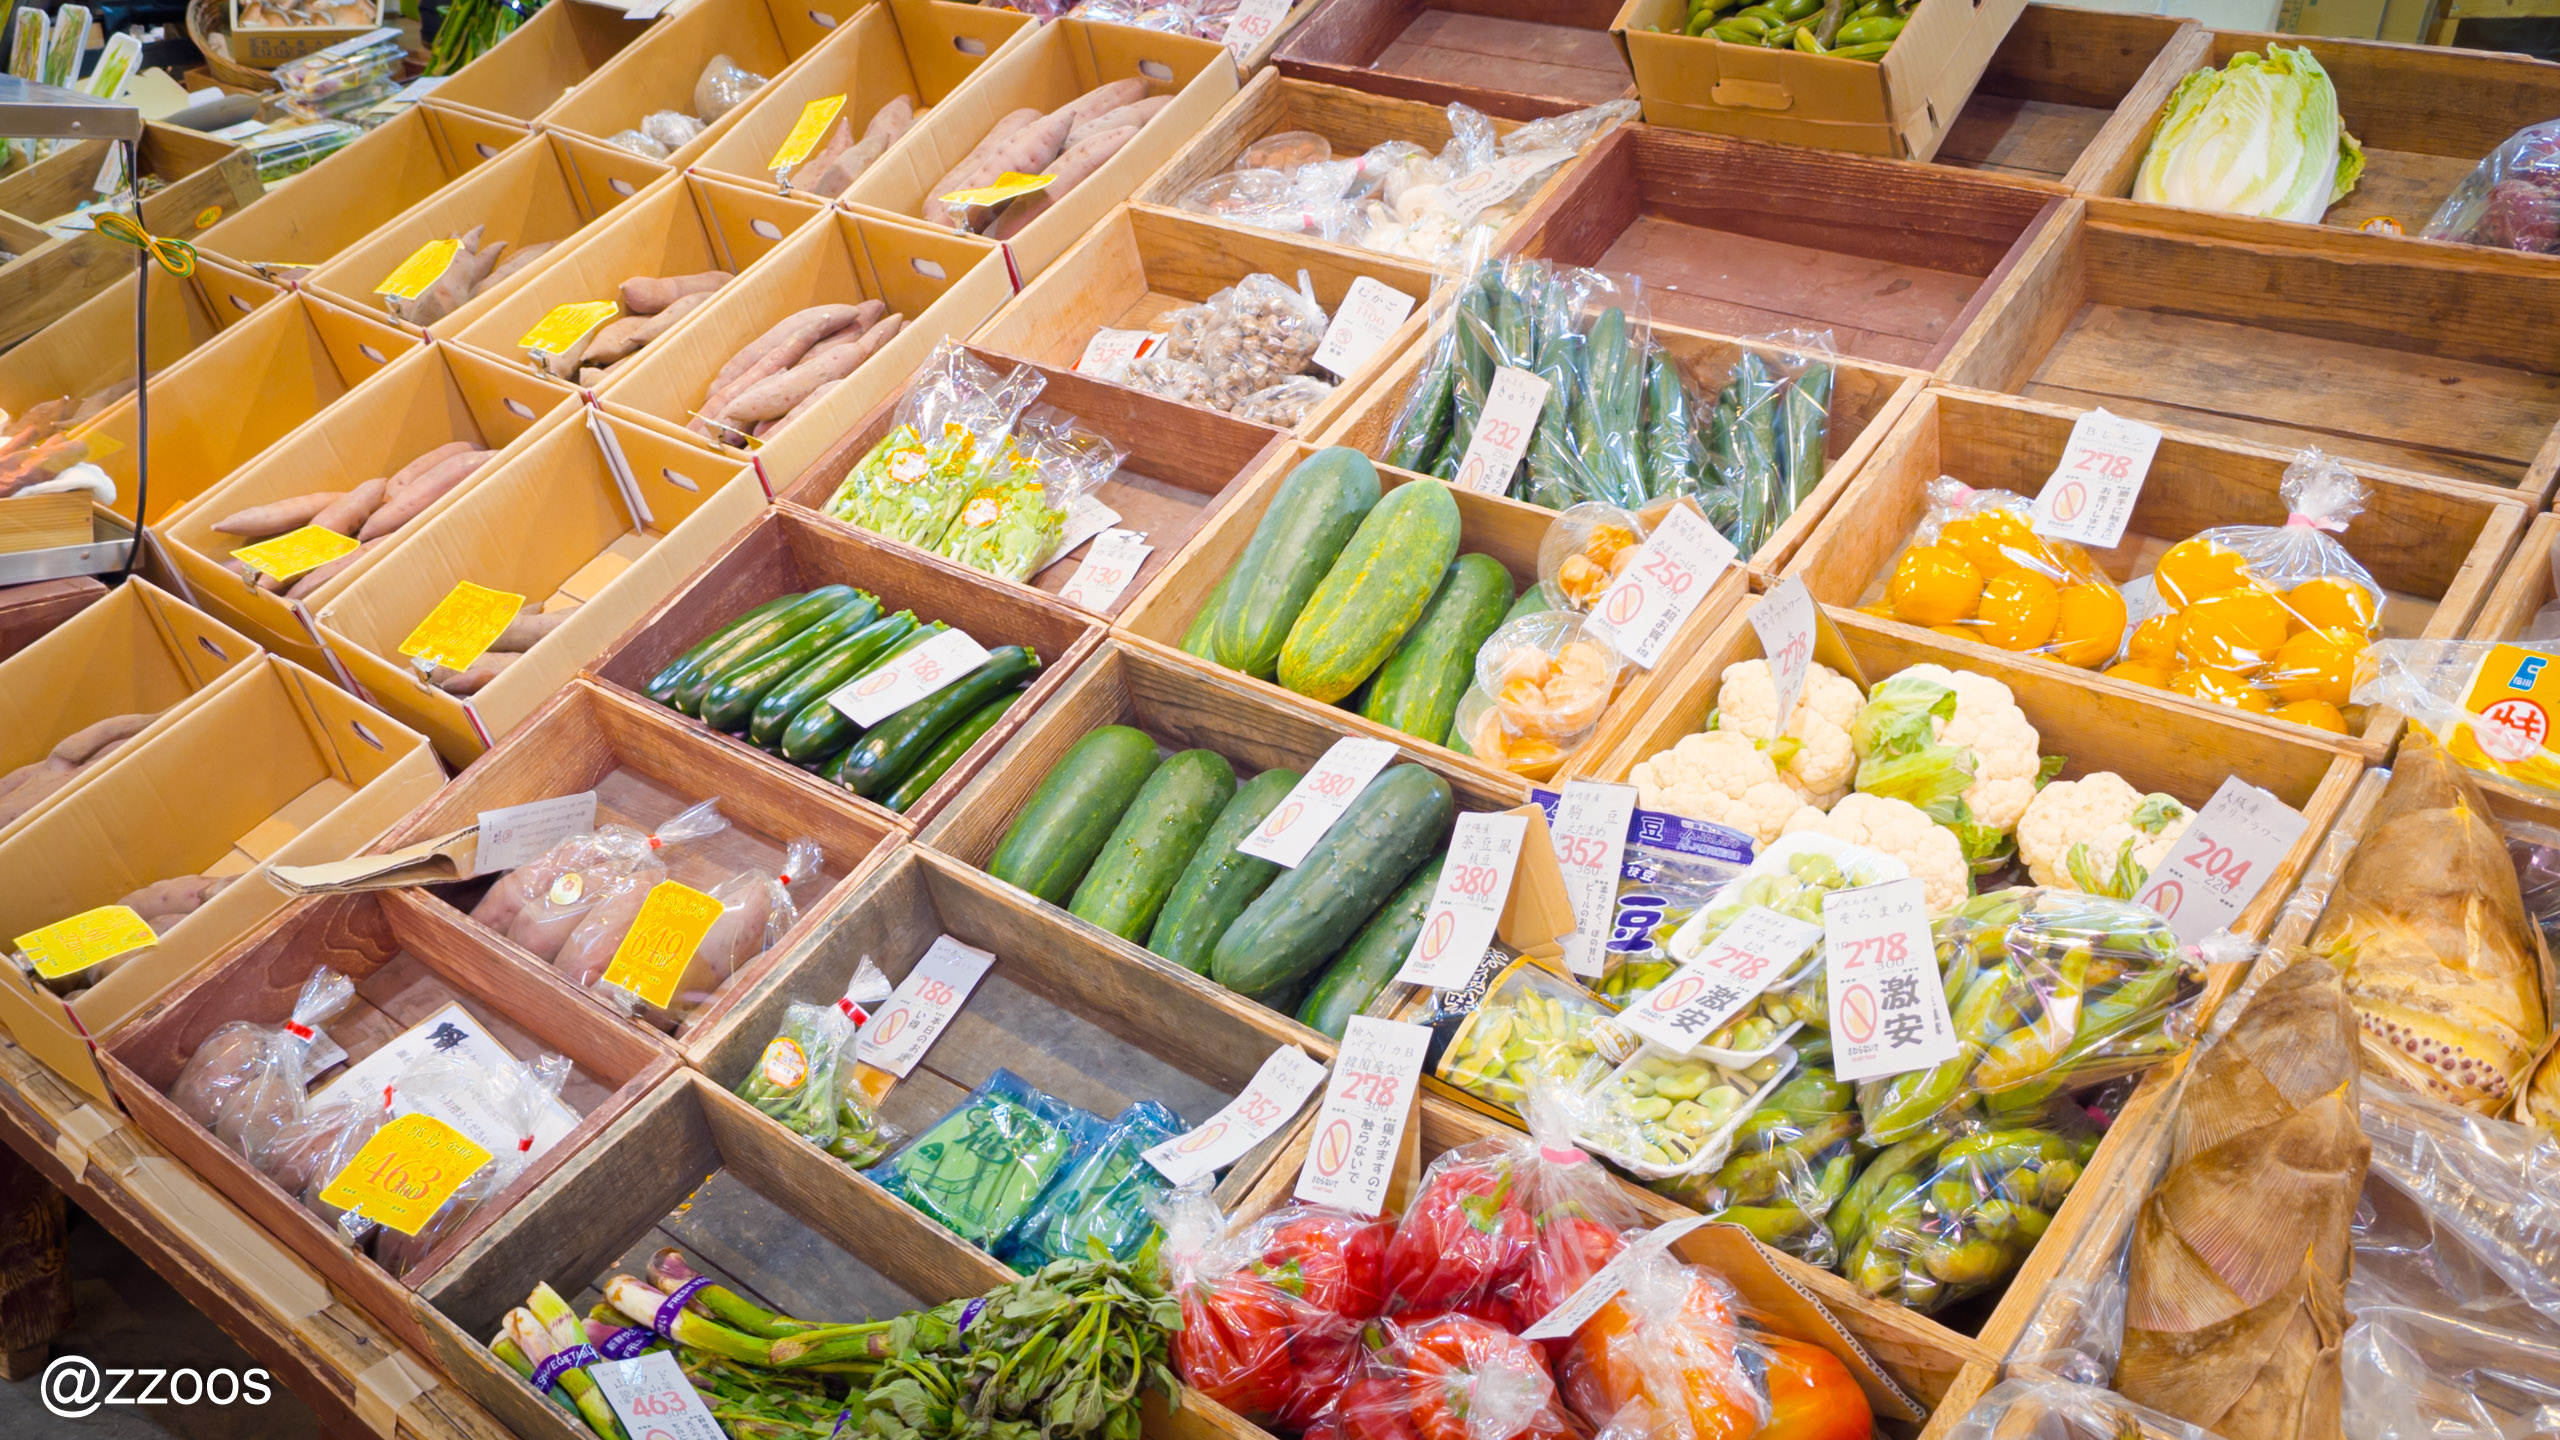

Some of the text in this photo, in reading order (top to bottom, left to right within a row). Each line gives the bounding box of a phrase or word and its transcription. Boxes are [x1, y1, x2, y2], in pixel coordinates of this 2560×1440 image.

[1238, 14, 1271, 37] 453
[1498, 385, 1536, 408] きゅうり
[1482, 418, 1521, 451] 232
[2074, 449, 2133, 479] 278
[2083, 487, 2111, 537] お売りしません
[1086, 564, 1123, 586] 130
[1642, 551, 1693, 595] 250
[908, 652, 945, 683] 186
[1780, 631, 1807, 678] 278
[1308, 771, 1356, 797] 380
[2221, 790, 2260, 816] 大阪産
[1567, 823, 1607, 838] えだまめ
[1639, 815, 1666, 840] 豆
[2216, 803, 2282, 844] カリフラワー
[1461, 835, 1512, 854] 茶豆風
[1469, 852, 1491, 866] 枝豆
[1557, 834, 1608, 869] 352
[1576, 864, 1600, 876] 380
[1626, 865, 1657, 884] 枝豆
[2183, 838, 2252, 889] 204
[1449, 864, 1498, 896] 380
[2203, 875, 2231, 895] 220
[1839, 902, 1913, 925] そらまめ
[630, 922, 684, 965] 649
[1742, 924, 1798, 950] そらまめ
[1844, 932, 1910, 970] 278
[1707, 947, 1770, 980] 278
[1876, 957, 1905, 971] 300
[914, 976, 955, 1006] 186
[1670, 984, 1741, 1034] 激安
[1879, 974, 1925, 1049] 激安
[1345, 1055, 1410, 1078] 韓国産など
[1340, 1071, 1398, 1106] 278
[1237, 1092, 1282, 1127] 352
[1364, 1102, 1389, 1113] 300
[1348, 1117, 1376, 1185] 触らないで
[1365, 1122, 1396, 1203] 傷みますので
[364, 1151, 442, 1201] 463
[666, 1285, 694, 1309] FRESH
[632, 1391, 688, 1418] 463
